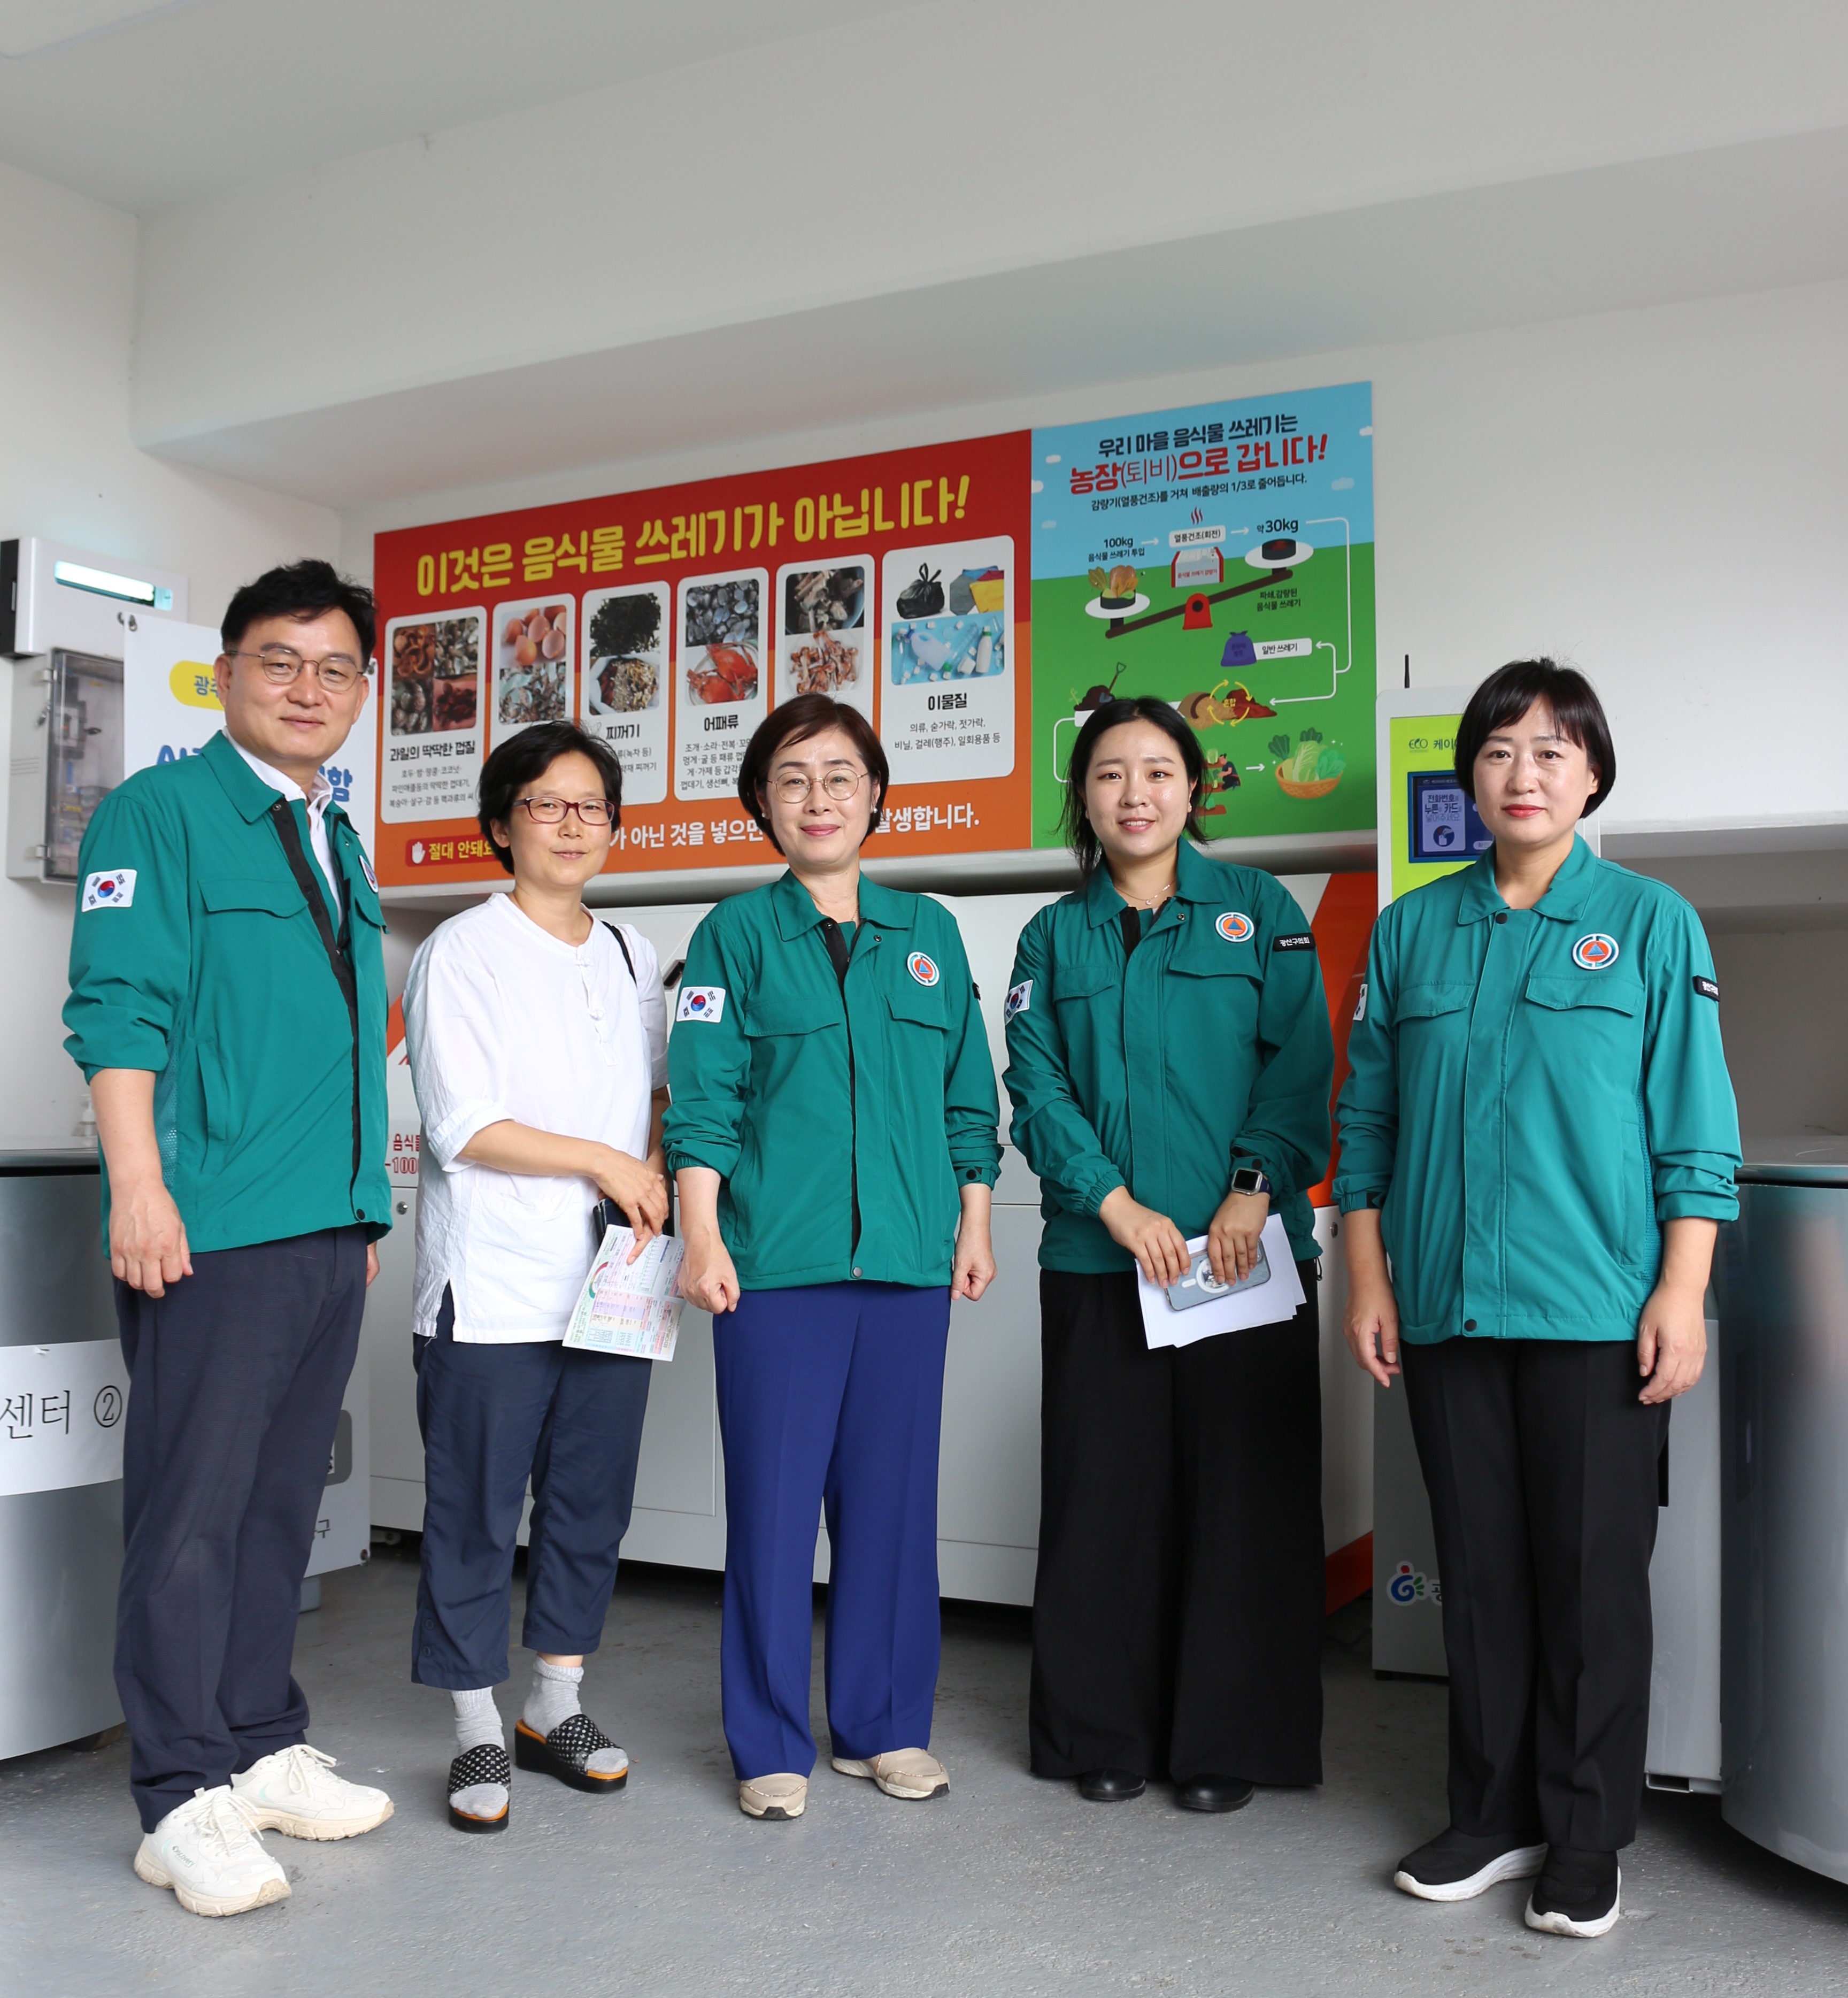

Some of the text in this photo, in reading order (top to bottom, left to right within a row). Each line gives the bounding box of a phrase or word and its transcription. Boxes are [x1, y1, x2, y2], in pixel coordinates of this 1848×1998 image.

[1099, 414, 1298, 457] 우리 마을 음식물 쓰레기는
[1069, 434, 1328, 495] 농장(퇴비)으로 갑니다!
[1091, 473, 1307, 511] 감량기(열풍건조)를 거쳐 배출량의 1/3로 줄어듭니다.
[1266, 518, 1298, 533] 30kg
[417, 474, 970, 597] 이것은 음식물 쓰레기가 아닙니다!
[1104, 536, 1134, 548] 100kg
[1174, 529, 1221, 543] 열풍건조(회전)
[1088, 548, 1145, 562] 음식물 쓰레기 투입
[1257, 598, 1301, 612] 음식물 쓰레기
[1262, 643, 1298, 655] 일반 쓰레기
[928, 693, 967, 711] 이물질
[704, 714, 738, 731] 어패류
[910, 717, 985, 733] 의류, 숟가락, 젓가락,
[606, 724, 640, 740] 찌꺼기
[894, 732, 1000, 751] 비닐, 걸레(행주), 일회용품 등
[390, 740, 475, 762] 과일의 딱딱한 껍질
[642, 746, 651, 757] 등)
[710, 754, 717, 764] 등
[719, 752, 733, 762] 패류
[714, 766, 721, 775] 등
[724, 764, 741, 774] 갑각
[319, 765, 352, 802] 함
[630, 824, 665, 849] 아닌
[670, 821, 705, 847] 것을
[711, 819, 764, 844] 넣으면
[429, 842, 454, 860] 절대
[1279, 936, 1311, 947] 광산구의회
[0, 1389, 70, 1439] 센터
